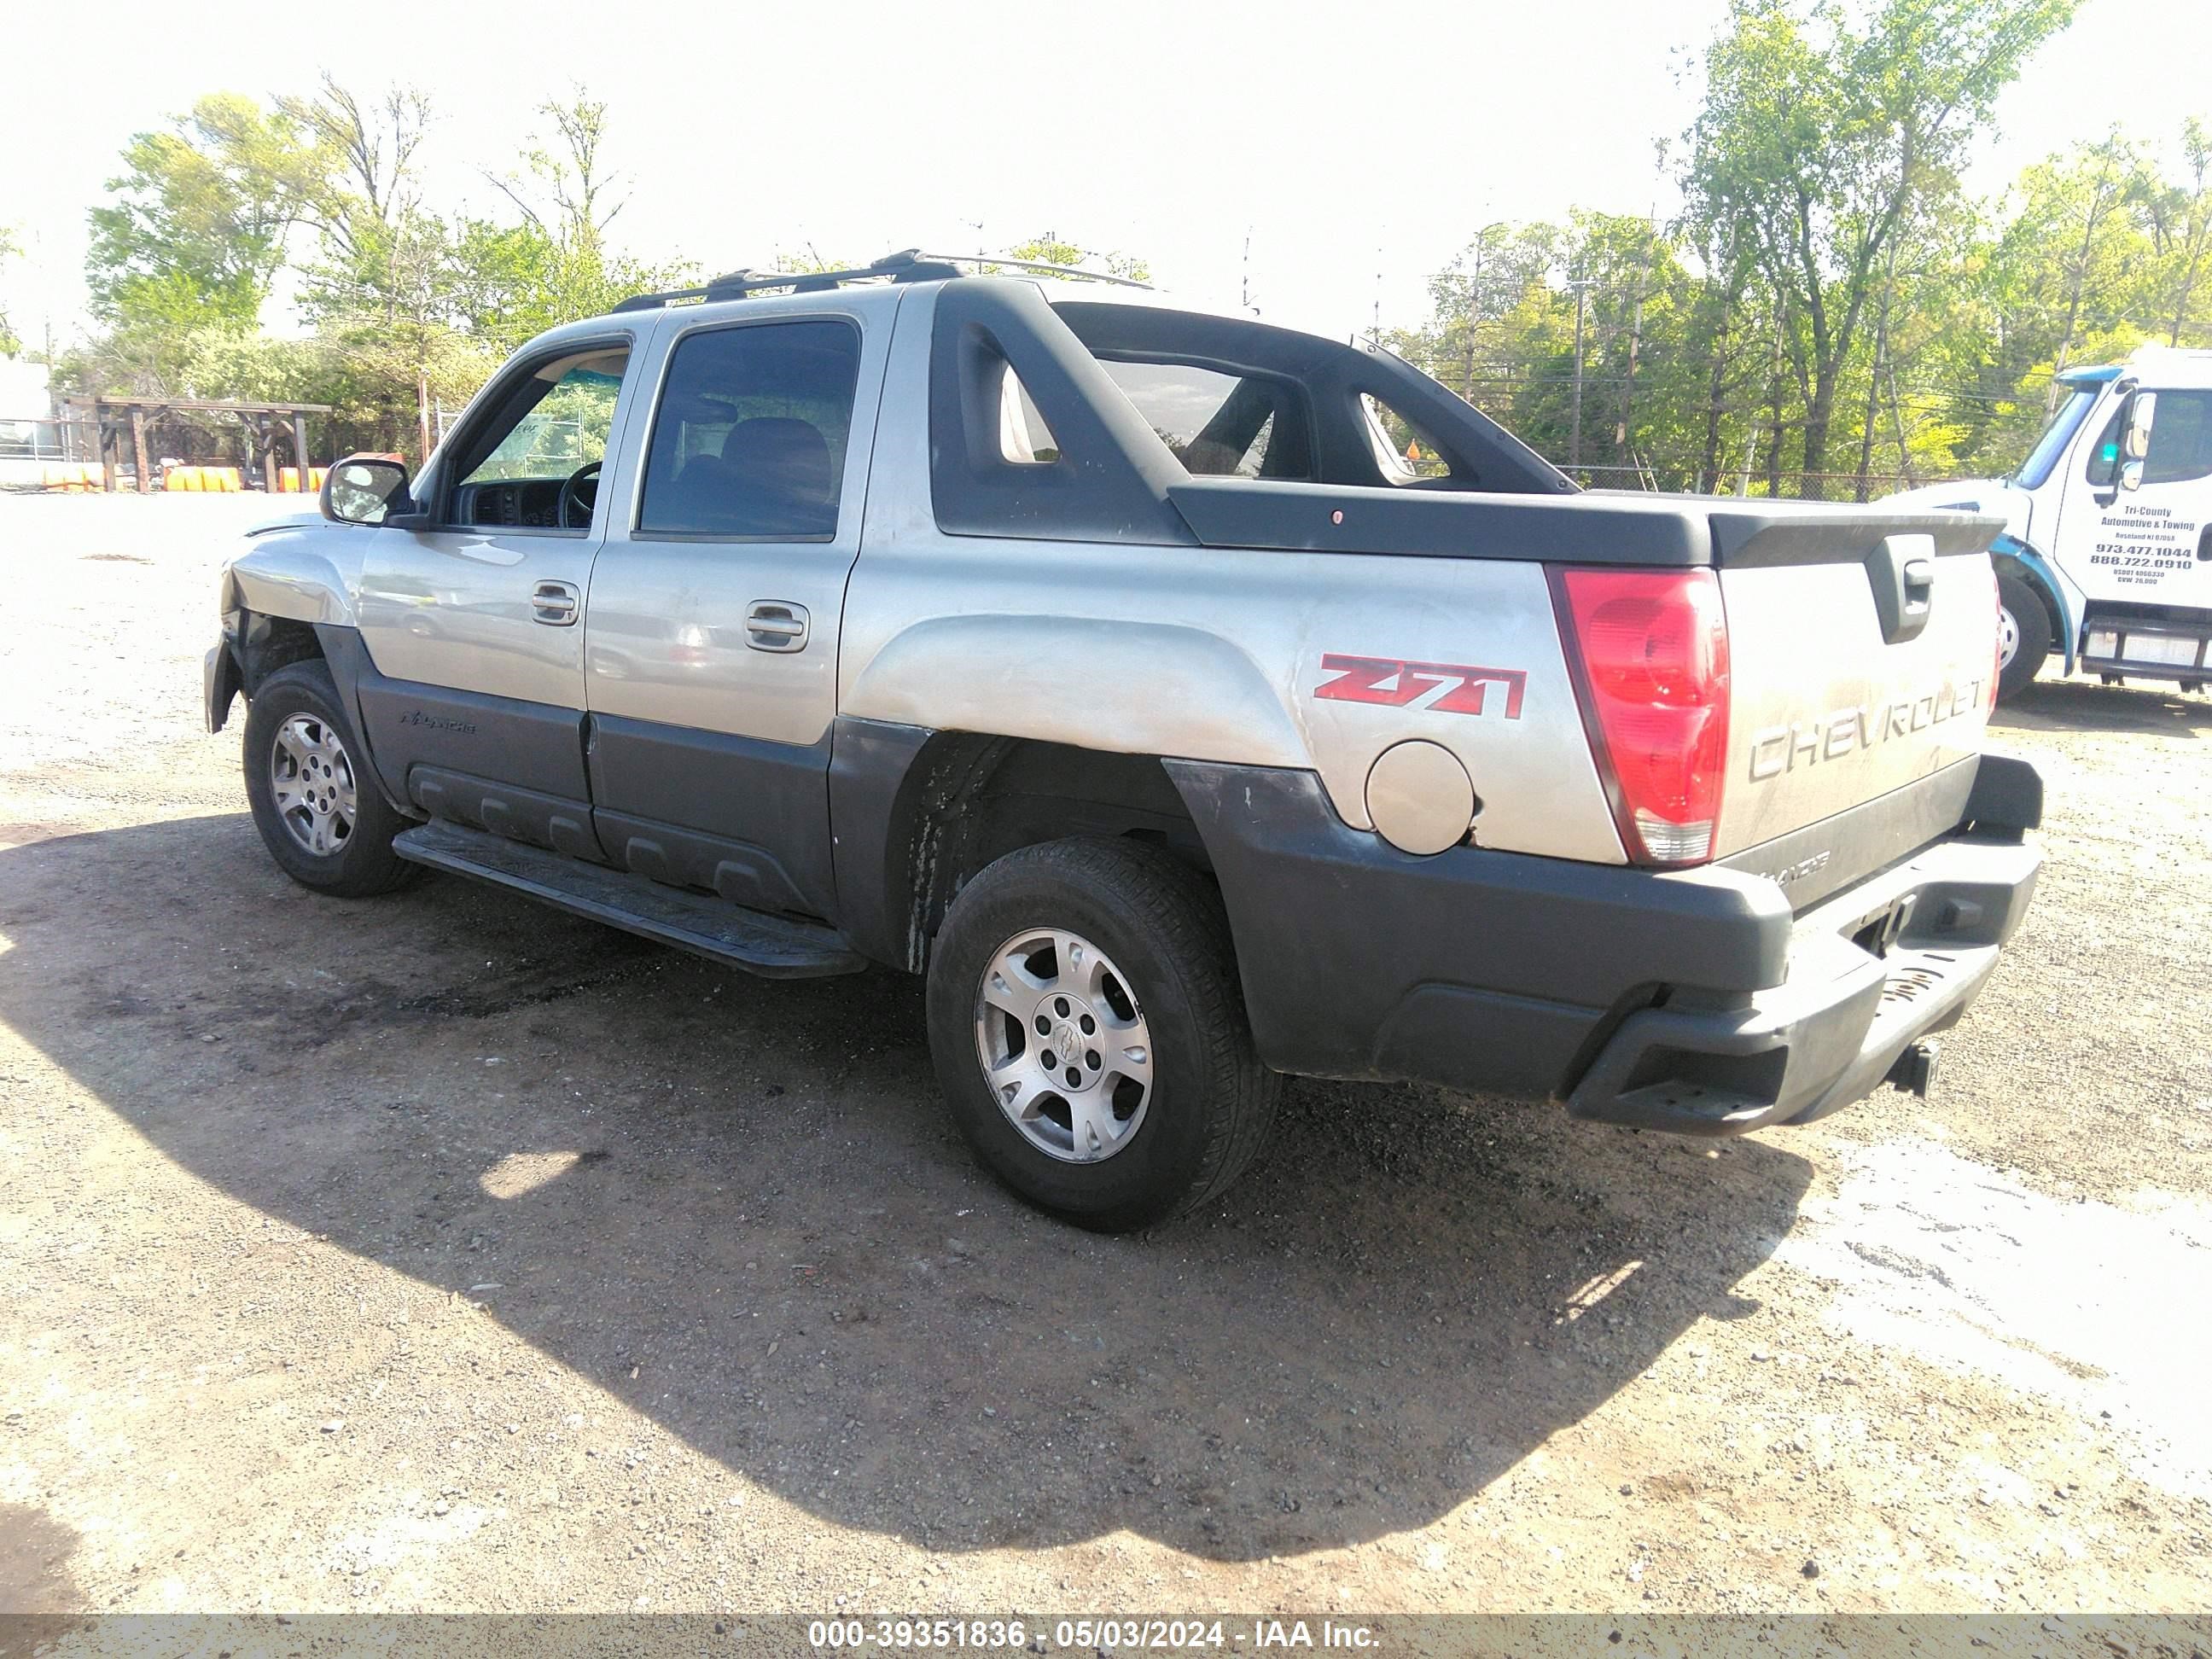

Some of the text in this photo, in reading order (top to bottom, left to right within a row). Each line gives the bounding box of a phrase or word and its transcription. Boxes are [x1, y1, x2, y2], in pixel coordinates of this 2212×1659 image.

[2125, 505, 2171, 517] Tri-County
[2101, 516, 2152, 528] Automotive
[2163, 520, 2195, 531] Towing
[2096, 544, 2192, 557] 973.477.1044
[2091, 555, 2192, 569] 888.722.0910
[1313, 652, 1528, 720] Z71
[1749, 678, 1987, 784] CHEVROLET
